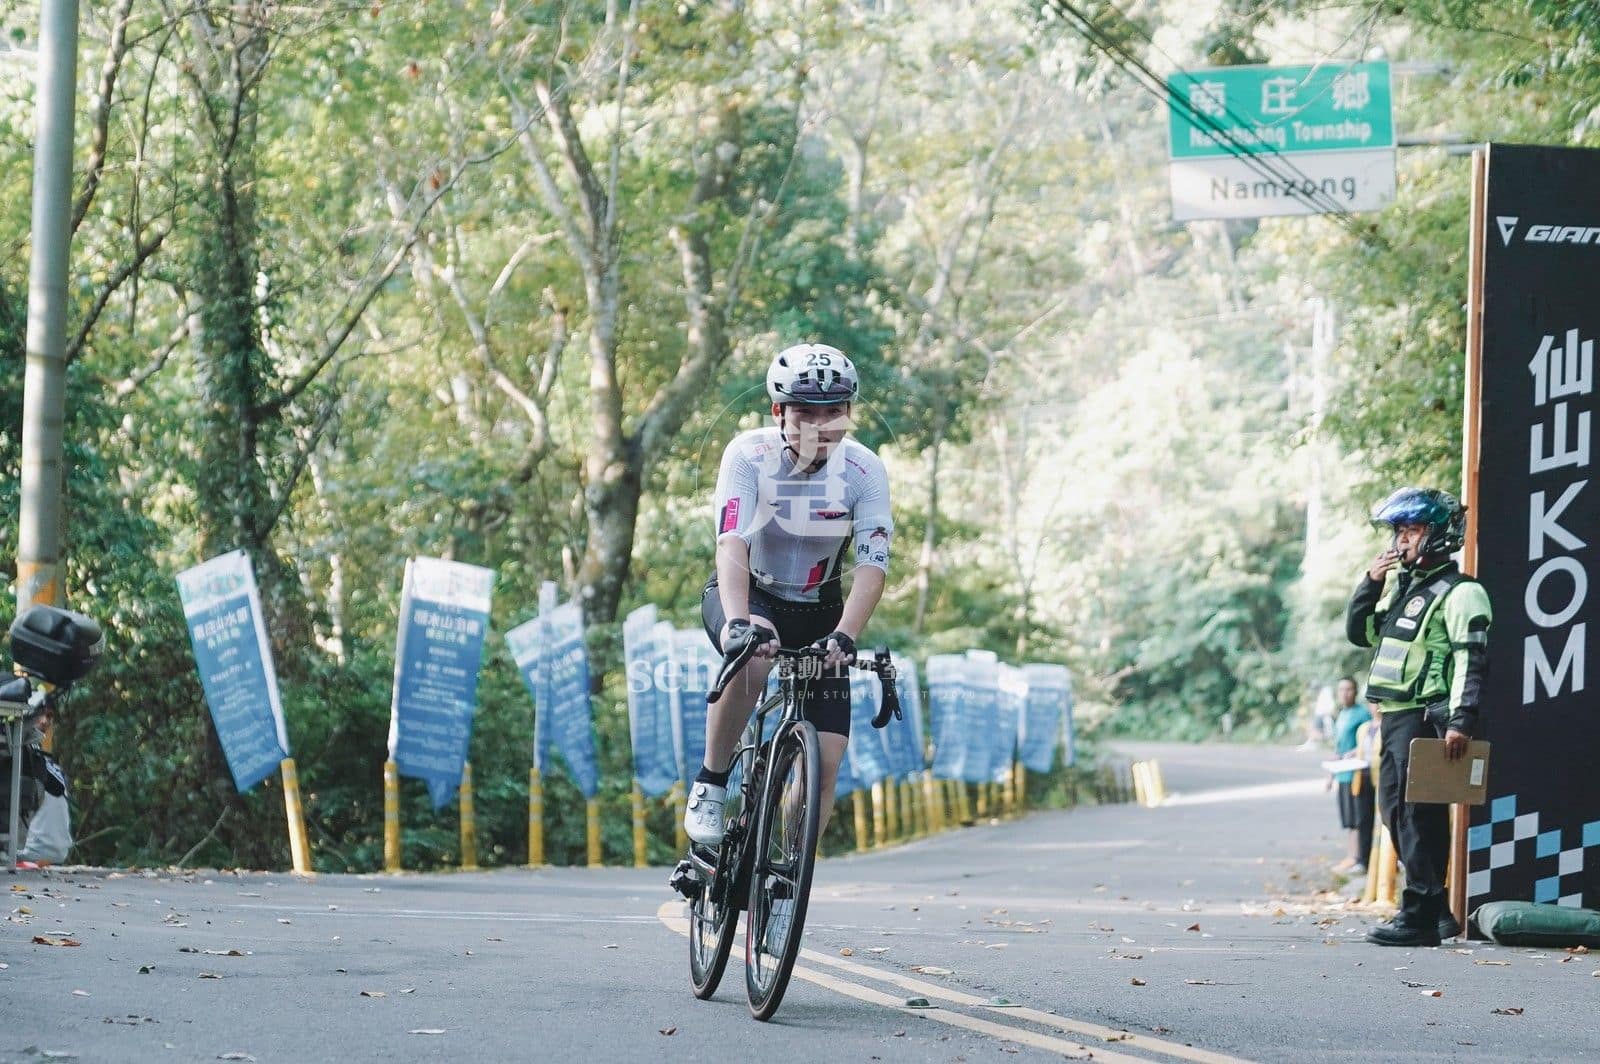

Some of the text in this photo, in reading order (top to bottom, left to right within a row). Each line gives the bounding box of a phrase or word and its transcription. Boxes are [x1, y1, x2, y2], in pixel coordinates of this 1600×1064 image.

[1292, 119, 1372, 144] Township
[1211, 175, 1357, 200] Namzong
[806, 353, 832, 367] 25
